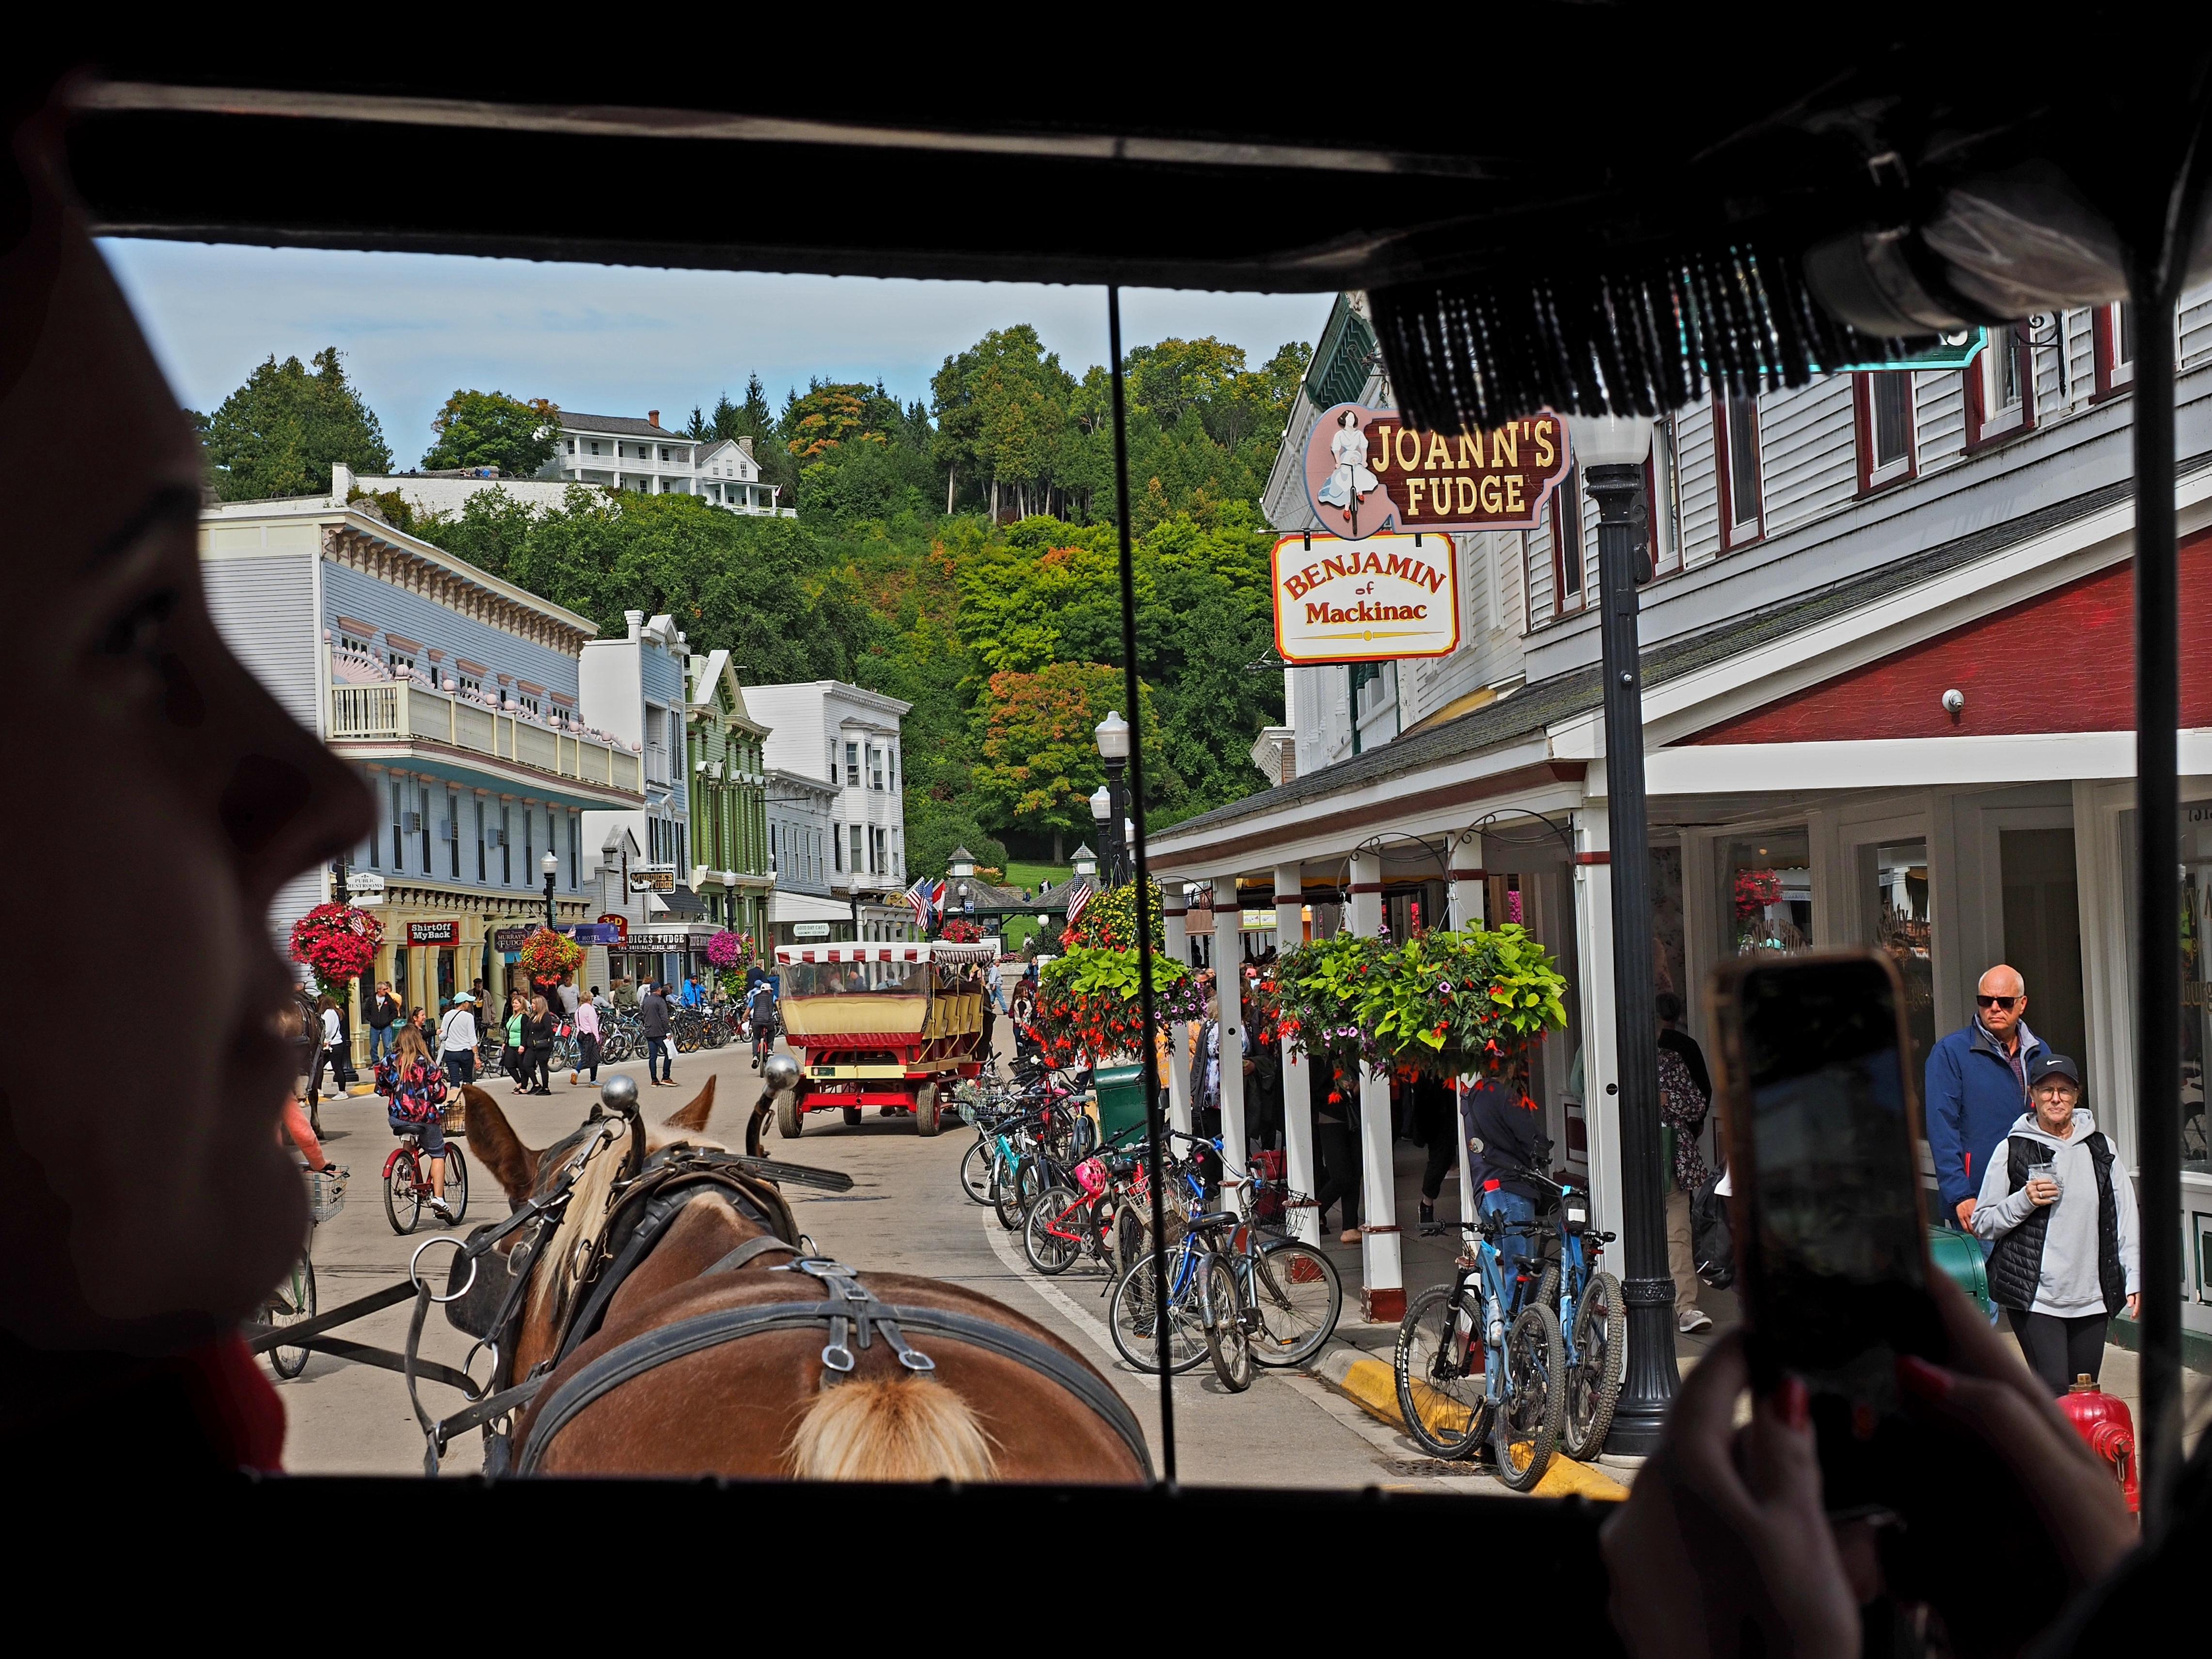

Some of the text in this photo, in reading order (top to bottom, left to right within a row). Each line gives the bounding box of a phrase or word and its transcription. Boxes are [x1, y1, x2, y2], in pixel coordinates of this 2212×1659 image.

[1372, 421, 1554, 472] JOANN'S
[1406, 474, 1526, 517] FUDGE
[1282, 551, 1447, 601] BENJAMIN
[1355, 582, 1375, 595] of
[1305, 601, 1428, 625] Mackinac
[632, 873, 673, 884] MURDICK'S
[626, 935, 653, 944] DICKS
[657, 934, 684, 944] FUDGE
[1396, 1328, 1406, 1369] MAXXIS
